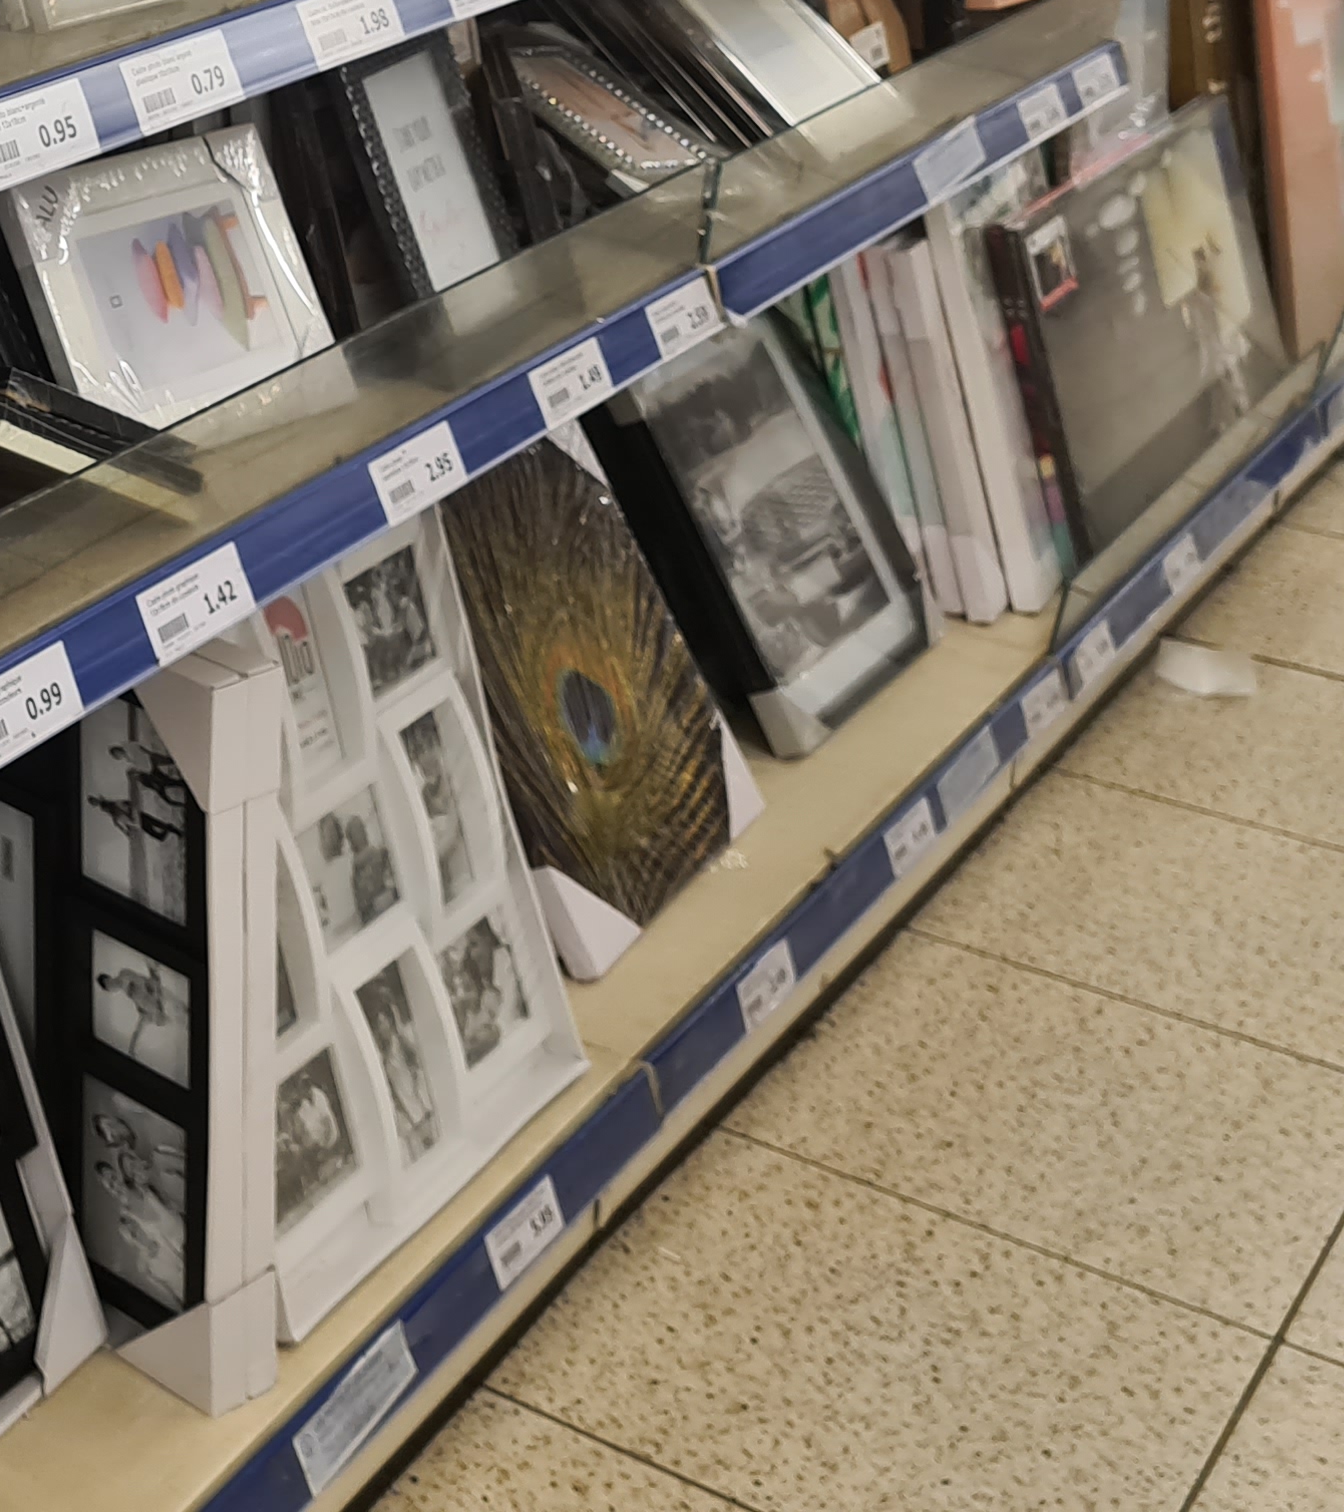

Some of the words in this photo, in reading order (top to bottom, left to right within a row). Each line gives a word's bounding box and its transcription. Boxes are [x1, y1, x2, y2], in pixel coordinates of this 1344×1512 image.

[191, 64, 225, 96] 0.79
[38, 114, 77, 148] 0.95
[203, 580, 238, 615] 1.42
[25, 682, 63, 720] 0.99
